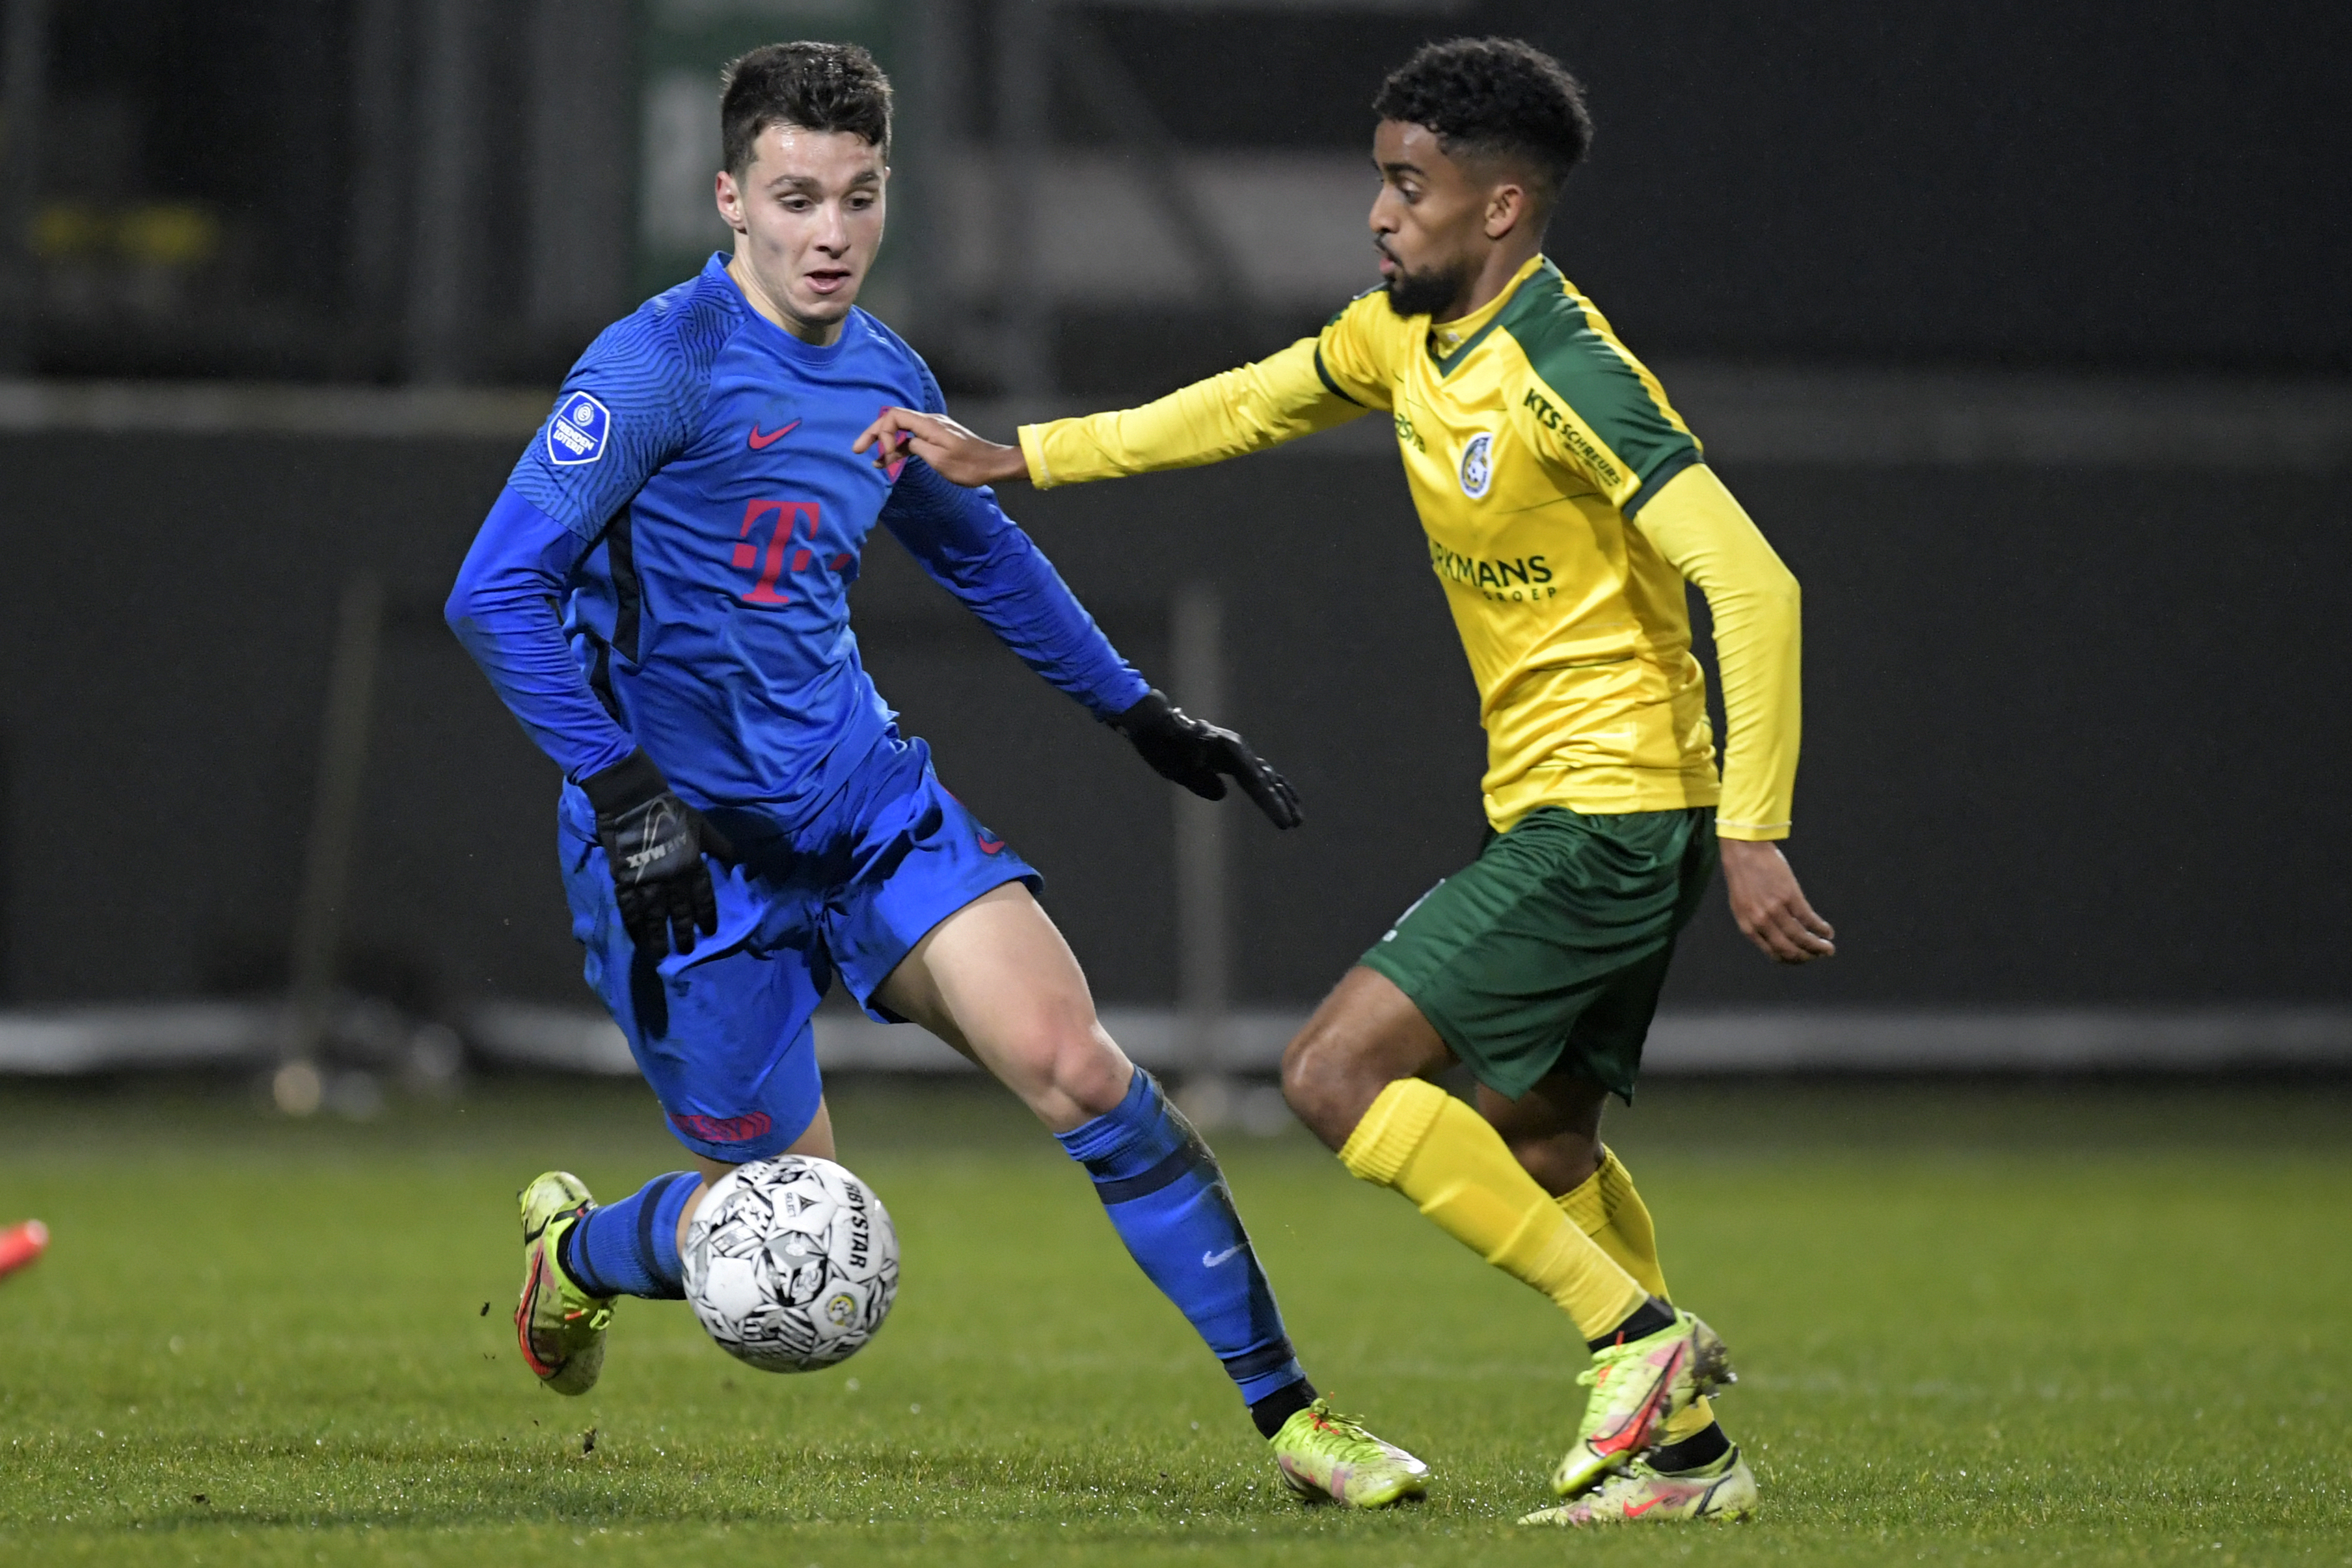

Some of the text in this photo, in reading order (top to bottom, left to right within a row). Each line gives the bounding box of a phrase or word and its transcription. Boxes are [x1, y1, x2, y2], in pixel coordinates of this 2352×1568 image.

[556, 418, 595, 451] VRIENDEN
[1522, 387, 1562, 430] KTS
[740, 499, 820, 603] T
[842, 1180, 869, 1268] RBYSTAR
